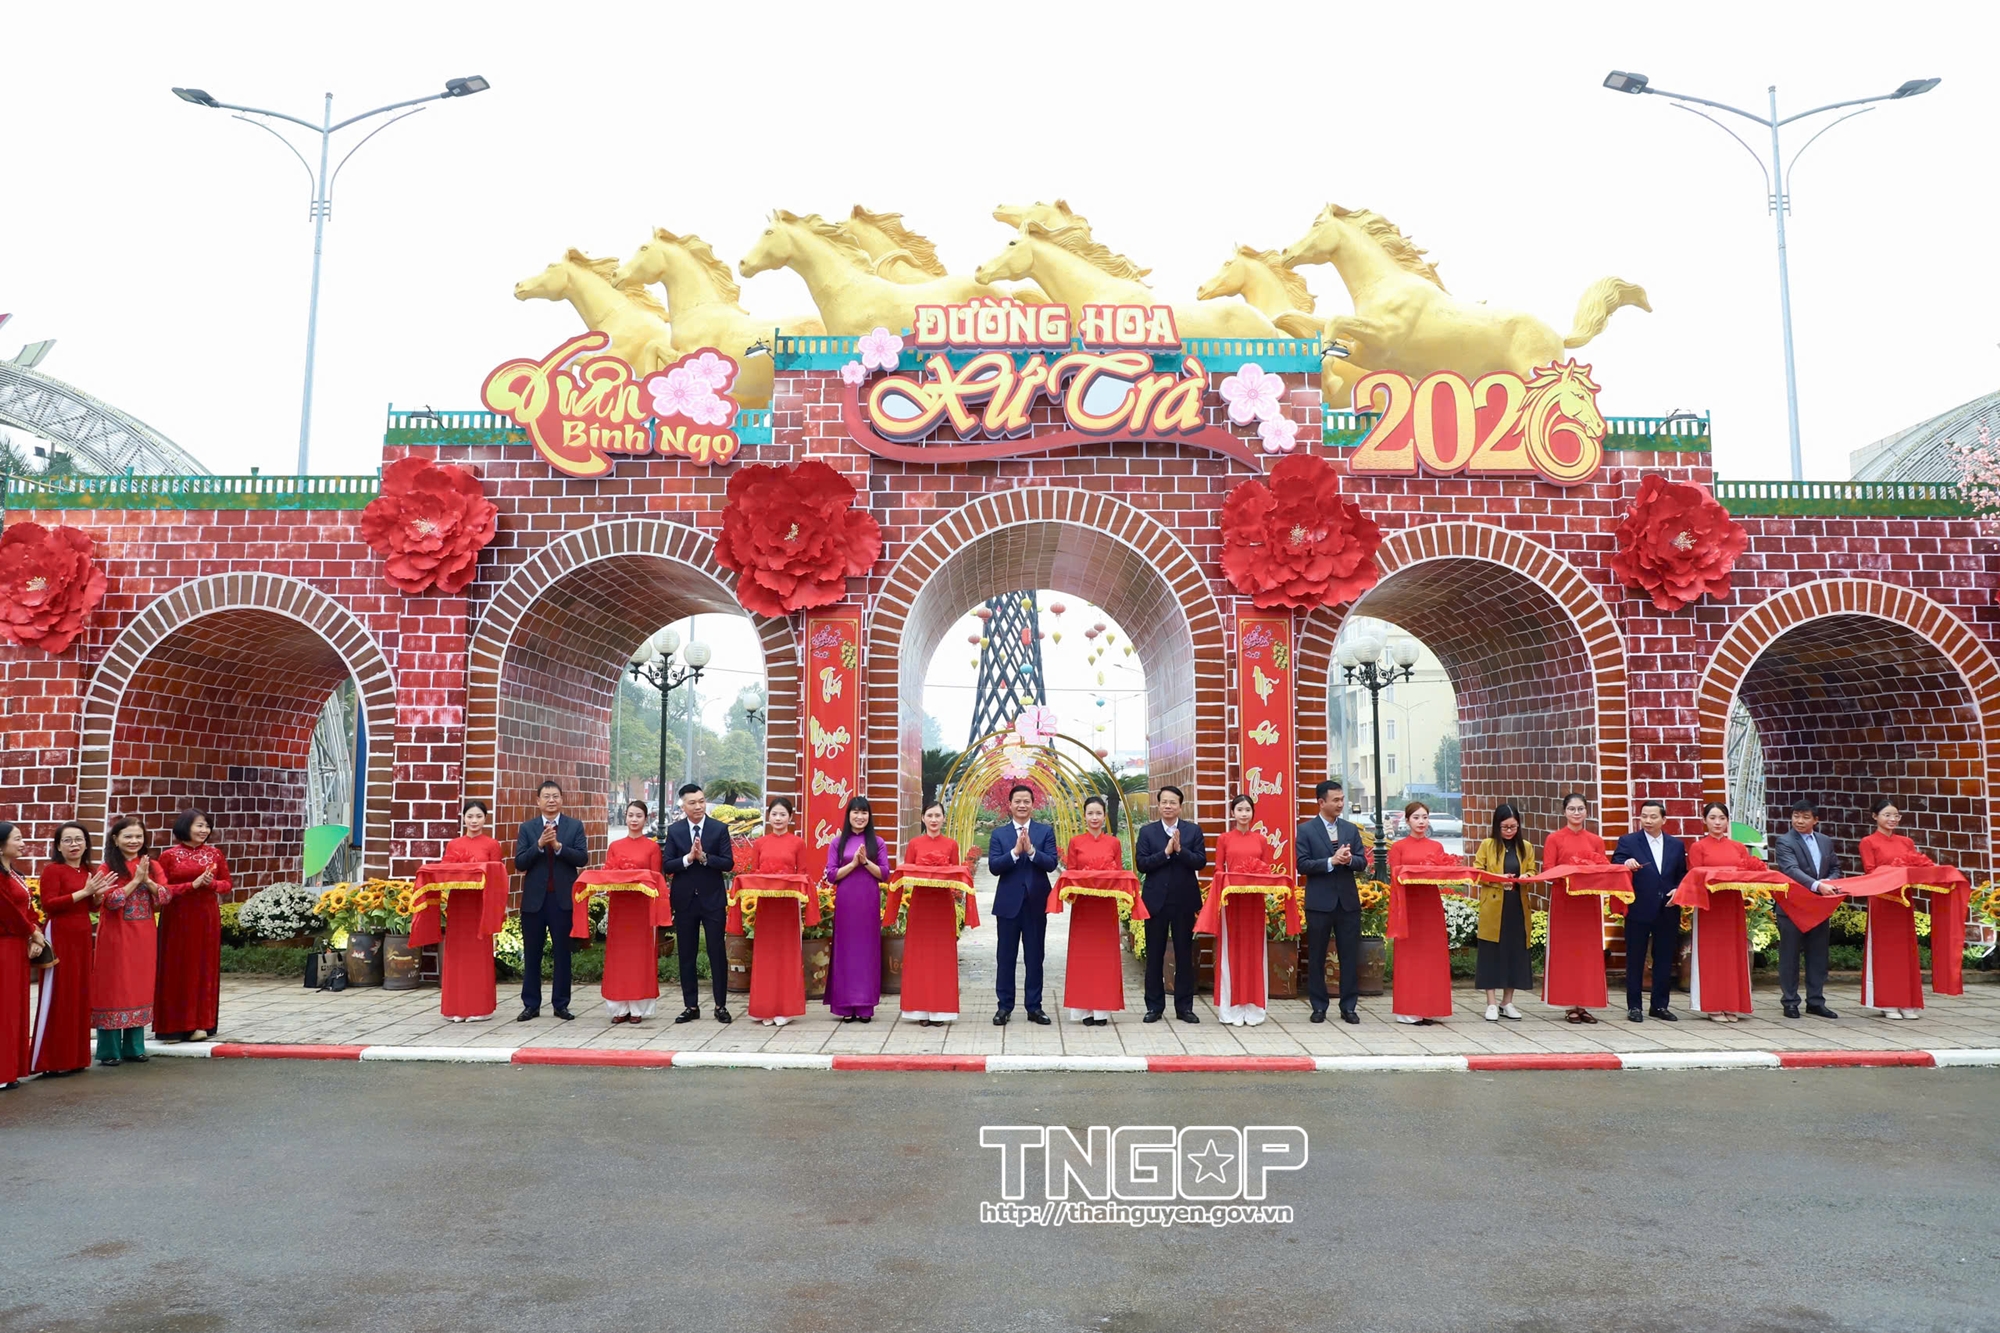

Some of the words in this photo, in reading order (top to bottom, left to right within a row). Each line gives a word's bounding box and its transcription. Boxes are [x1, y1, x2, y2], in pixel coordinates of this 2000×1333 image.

[916, 297, 1068, 345] ĐƯỜNG
[1080, 306, 1178, 345] HOA
[868, 353, 1047, 436] Xứ
[1046, 352, 1207, 435] Trà
[1350, 358, 1606, 482] 2026
[562, 419, 645, 450] Bính
[660, 425, 734, 462] Ngọ
